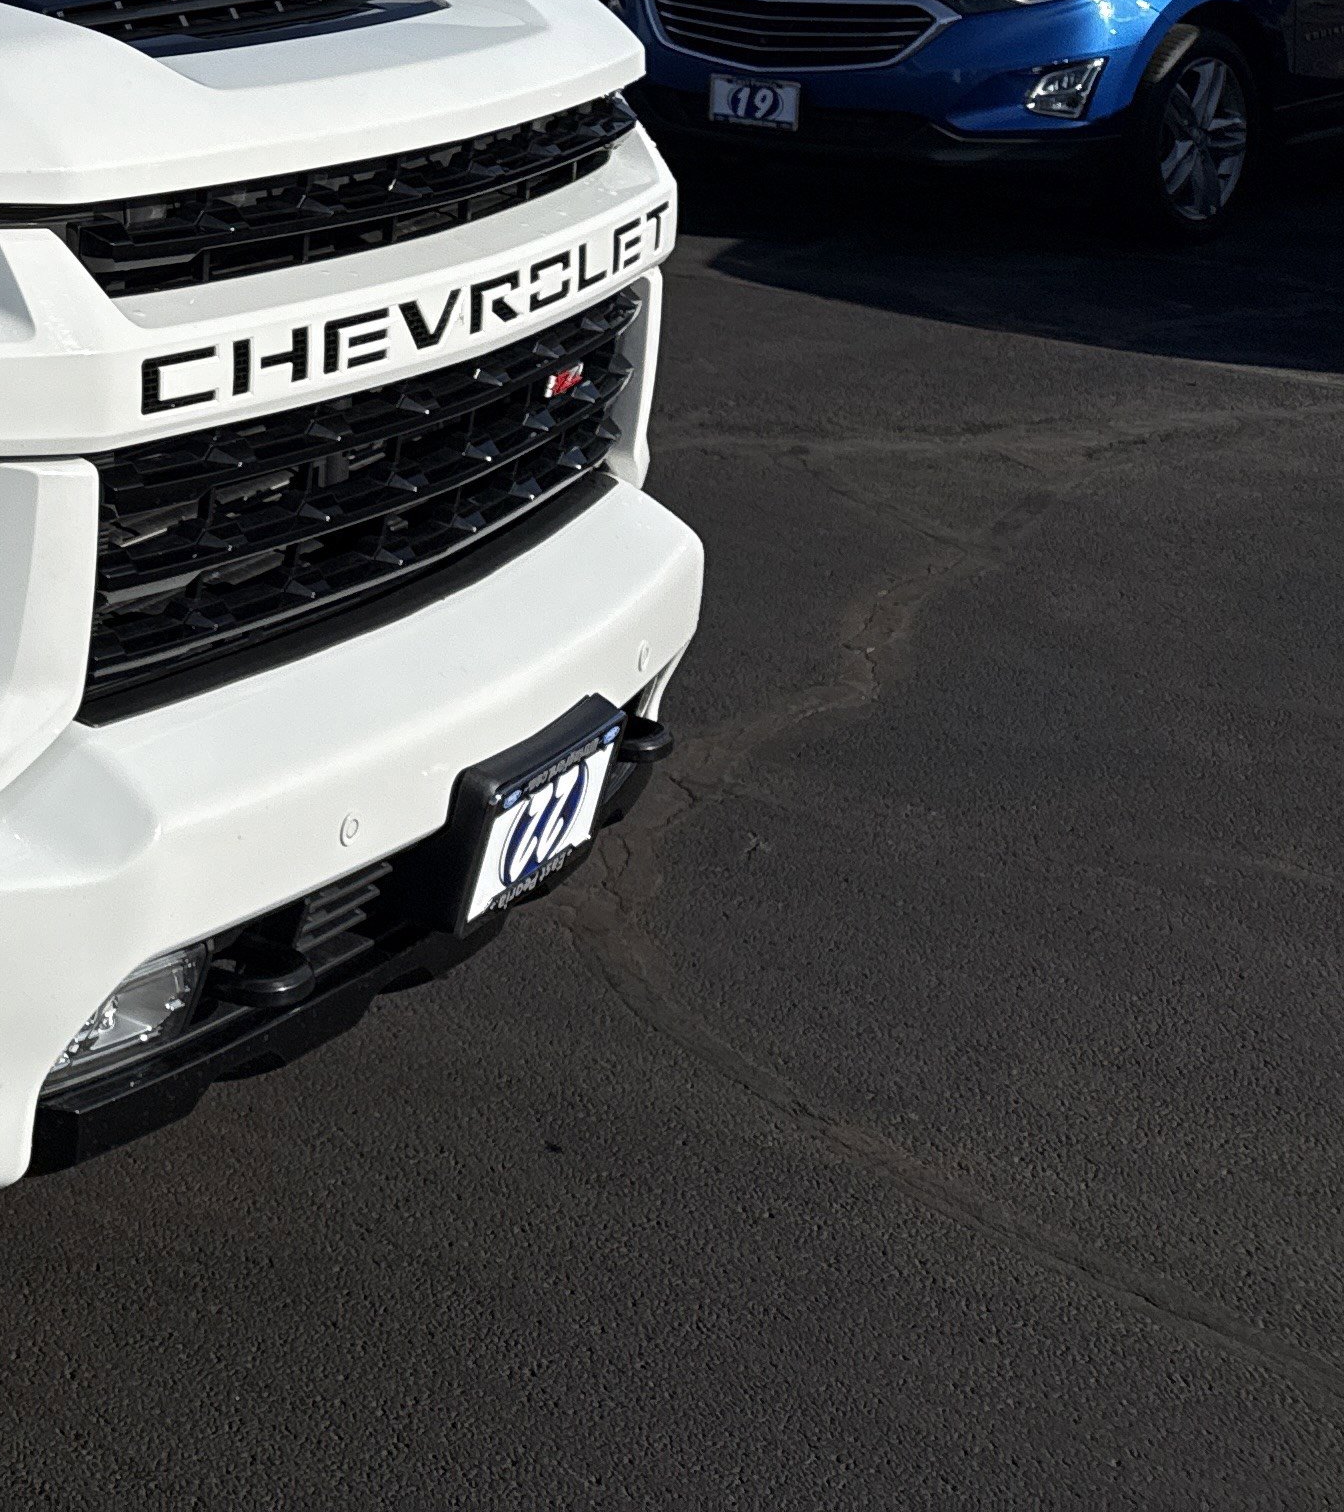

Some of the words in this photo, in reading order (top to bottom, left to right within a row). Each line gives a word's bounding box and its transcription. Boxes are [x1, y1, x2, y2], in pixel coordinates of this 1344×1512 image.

[736, 87, 775, 119] 19
[141, 202, 670, 416] CHEVROLET
[510, 764, 580, 883] 22
